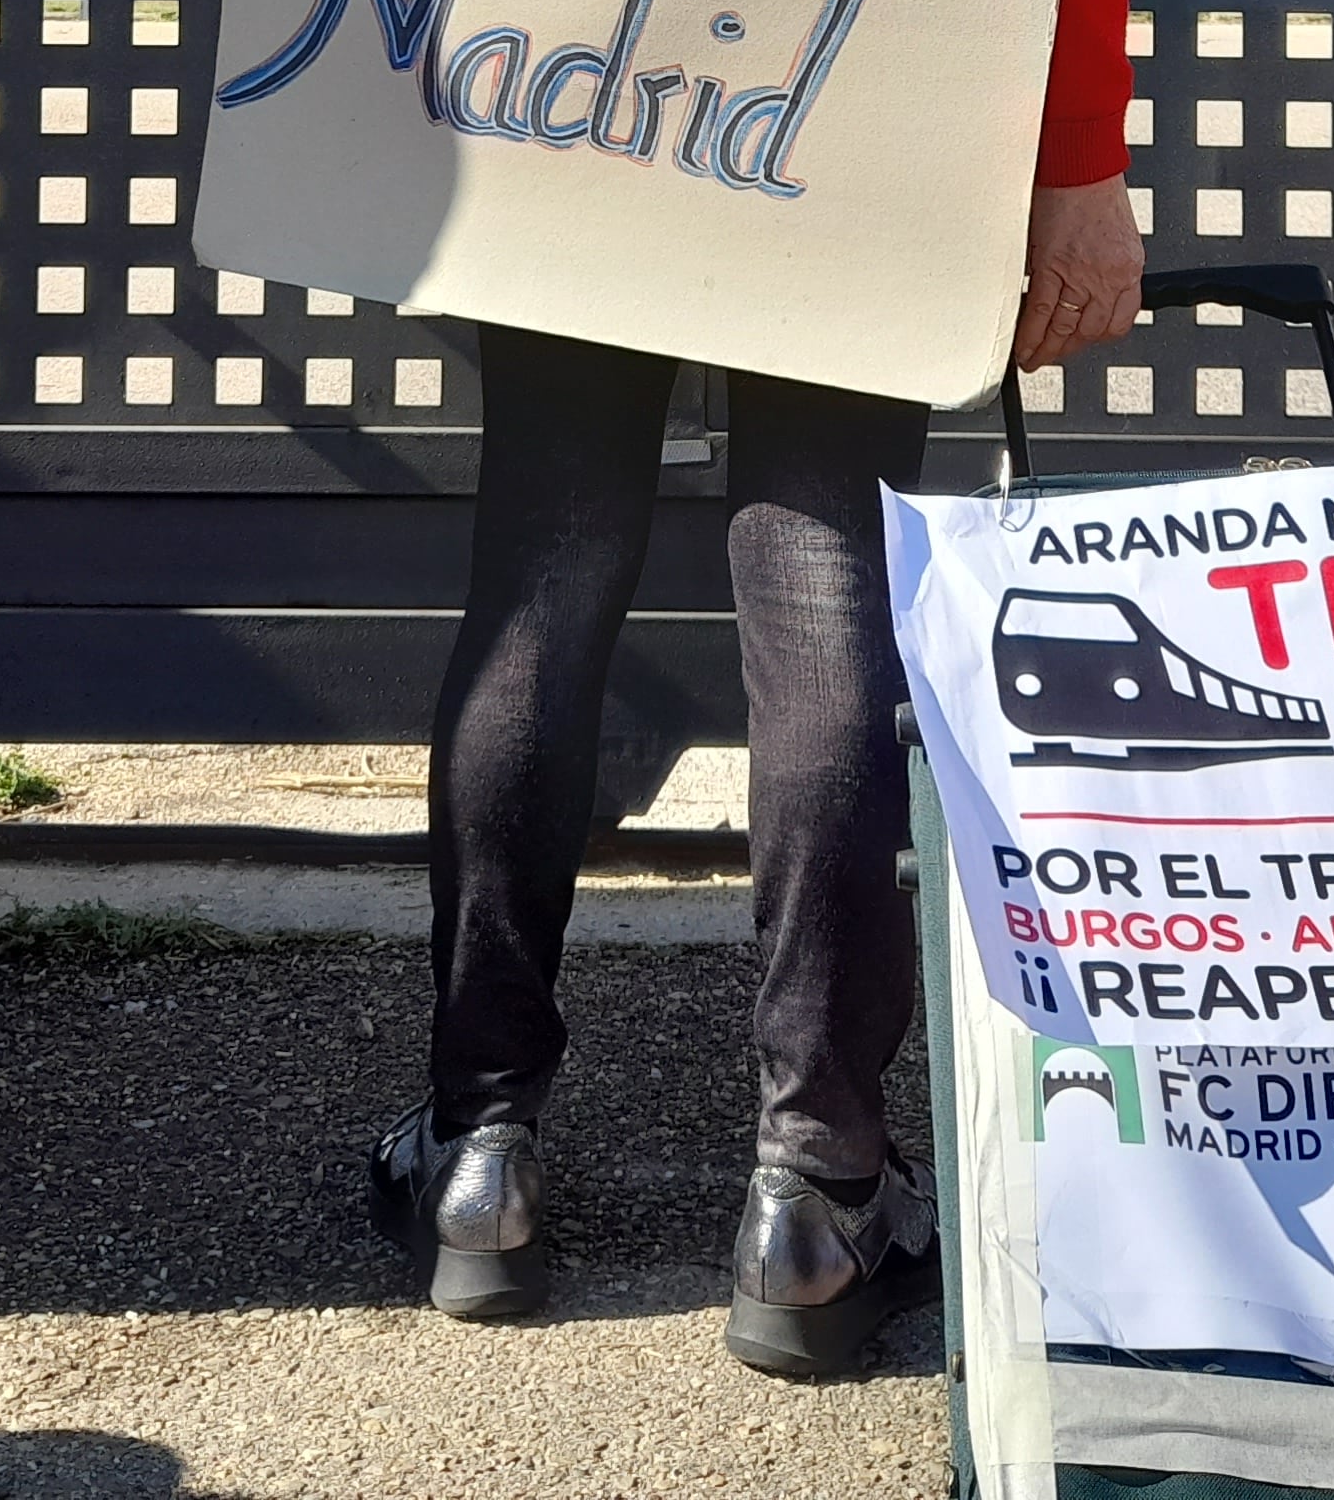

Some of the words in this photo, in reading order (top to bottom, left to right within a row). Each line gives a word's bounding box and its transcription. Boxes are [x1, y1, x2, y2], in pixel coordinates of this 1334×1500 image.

[1028, 501, 1308, 566] ARANDA
[991, 844, 1140, 900] POR
[1163, 852, 1251, 900] EL
[1002, 902, 1245, 954] BURGOS
[1158, 1069, 1235, 1122] FC
[1163, 1118, 1323, 1162] MADRID
